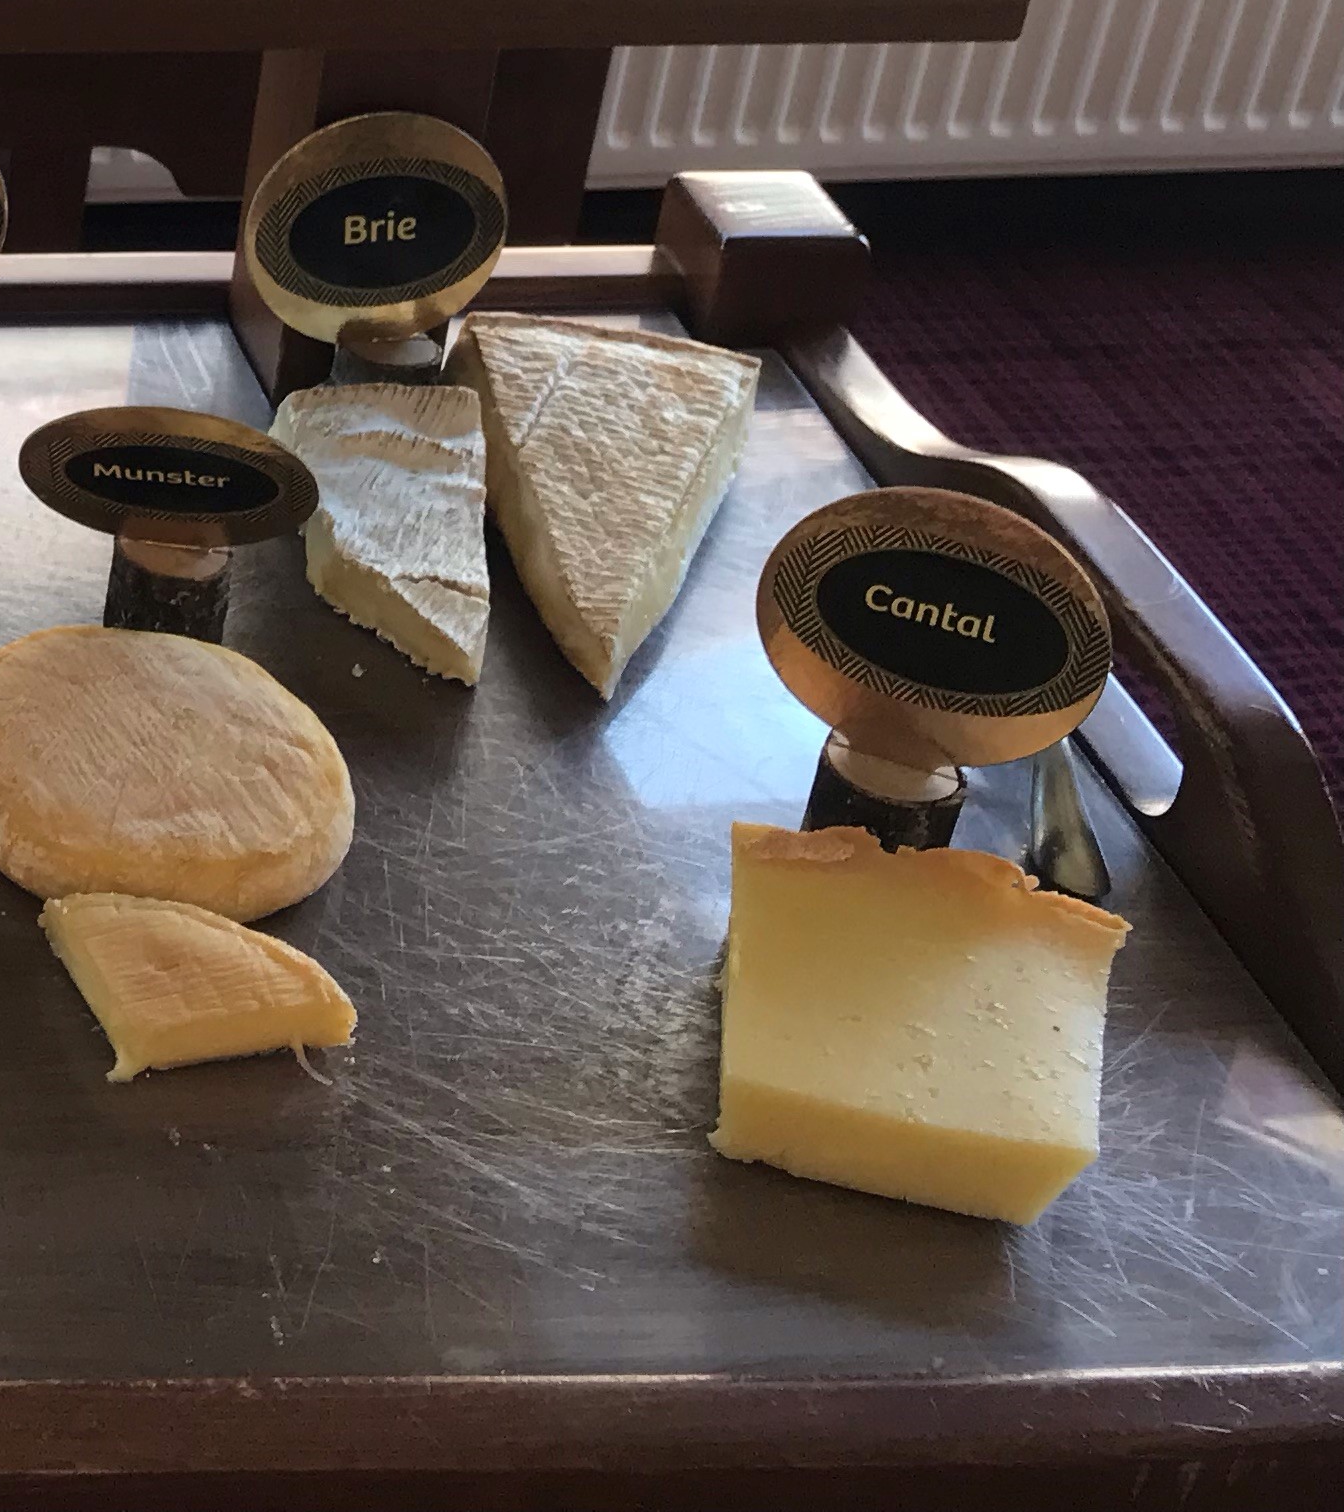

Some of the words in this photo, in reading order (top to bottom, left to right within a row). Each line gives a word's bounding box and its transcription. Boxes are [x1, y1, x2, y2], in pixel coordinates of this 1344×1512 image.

[344, 210, 417, 245] Brie
[94, 463, 230, 488] Munster
[865, 584, 996, 643] Cantal
